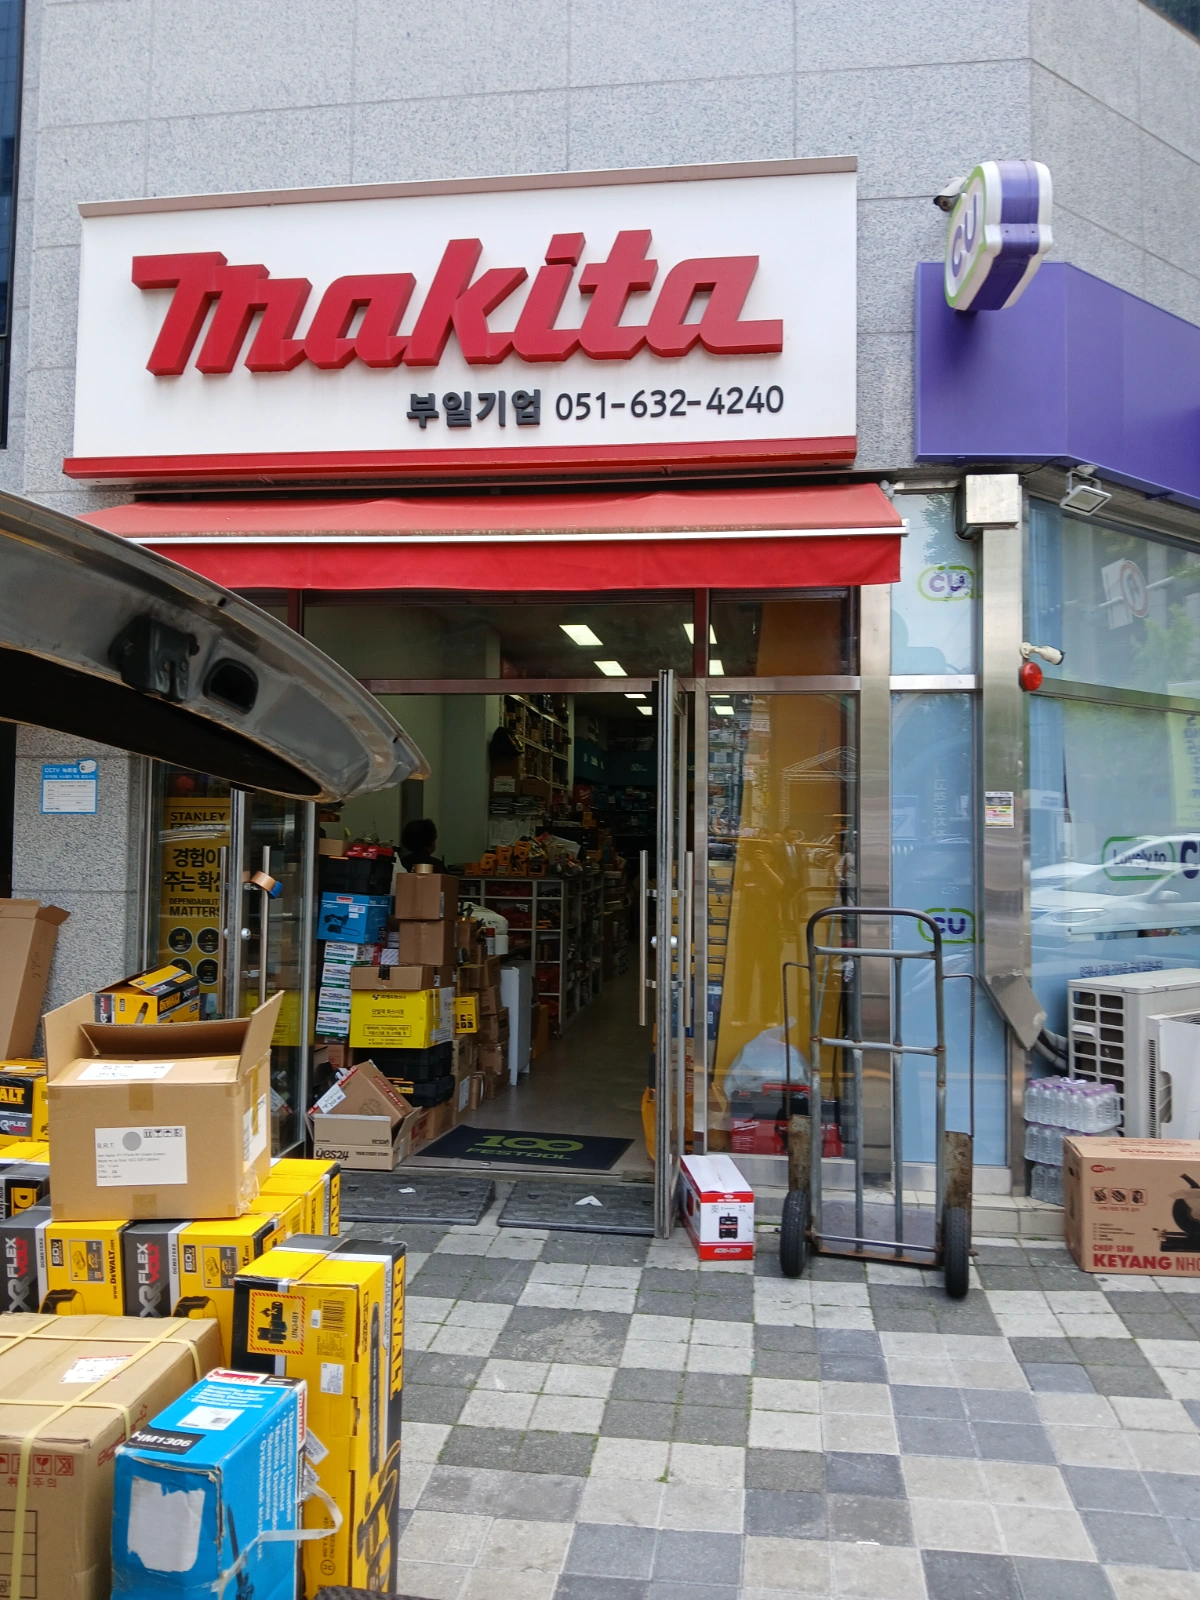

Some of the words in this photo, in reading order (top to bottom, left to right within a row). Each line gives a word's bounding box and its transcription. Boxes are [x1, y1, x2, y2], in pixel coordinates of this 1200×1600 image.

[406, 388, 541, 429] 부일기업
[556, 384, 784, 421] 051-632-4240
[170, 811, 226, 821] STANLEY
[172, 848, 221, 868] 경험이
[1113, 848, 1152, 871] Lovely
[1154, 850, 1167, 865] to
[1180, 840, 1200, 879] C
[164, 871, 196, 892] 주는
[316, 1148, 350, 1161] yes24
[465, 1147, 572, 1160] FESTOOL
[474, 1136, 584, 1152] 100
[330, 1174, 341, 1236] DEW
[5, 1237, 19, 1278] FLEX
[15, 1236, 28, 1278] VOLT
[136, 1243, 150, 1284] FLEX
[148, 1242, 160, 1284] VOLT
[1092, 1244, 1115, 1252] CHOP
[1093, 1253, 1172, 1271] KEYANG
[291, 1311, 299, 1339] UN3481
[390, 1255, 405, 1401] DEWALT
[131, 1431, 193, 1447] HM1306
[273, 1424, 282, 1470] Martillo
[287, 1411, 295, 1474] Demolition
[7, 1477, 57, 1489] 취주의
[272, 1470, 280, 1530] Demoledo
[279, 1466, 287, 1512] Piqueur
[286, 1474, 294, 1522] Hammer
